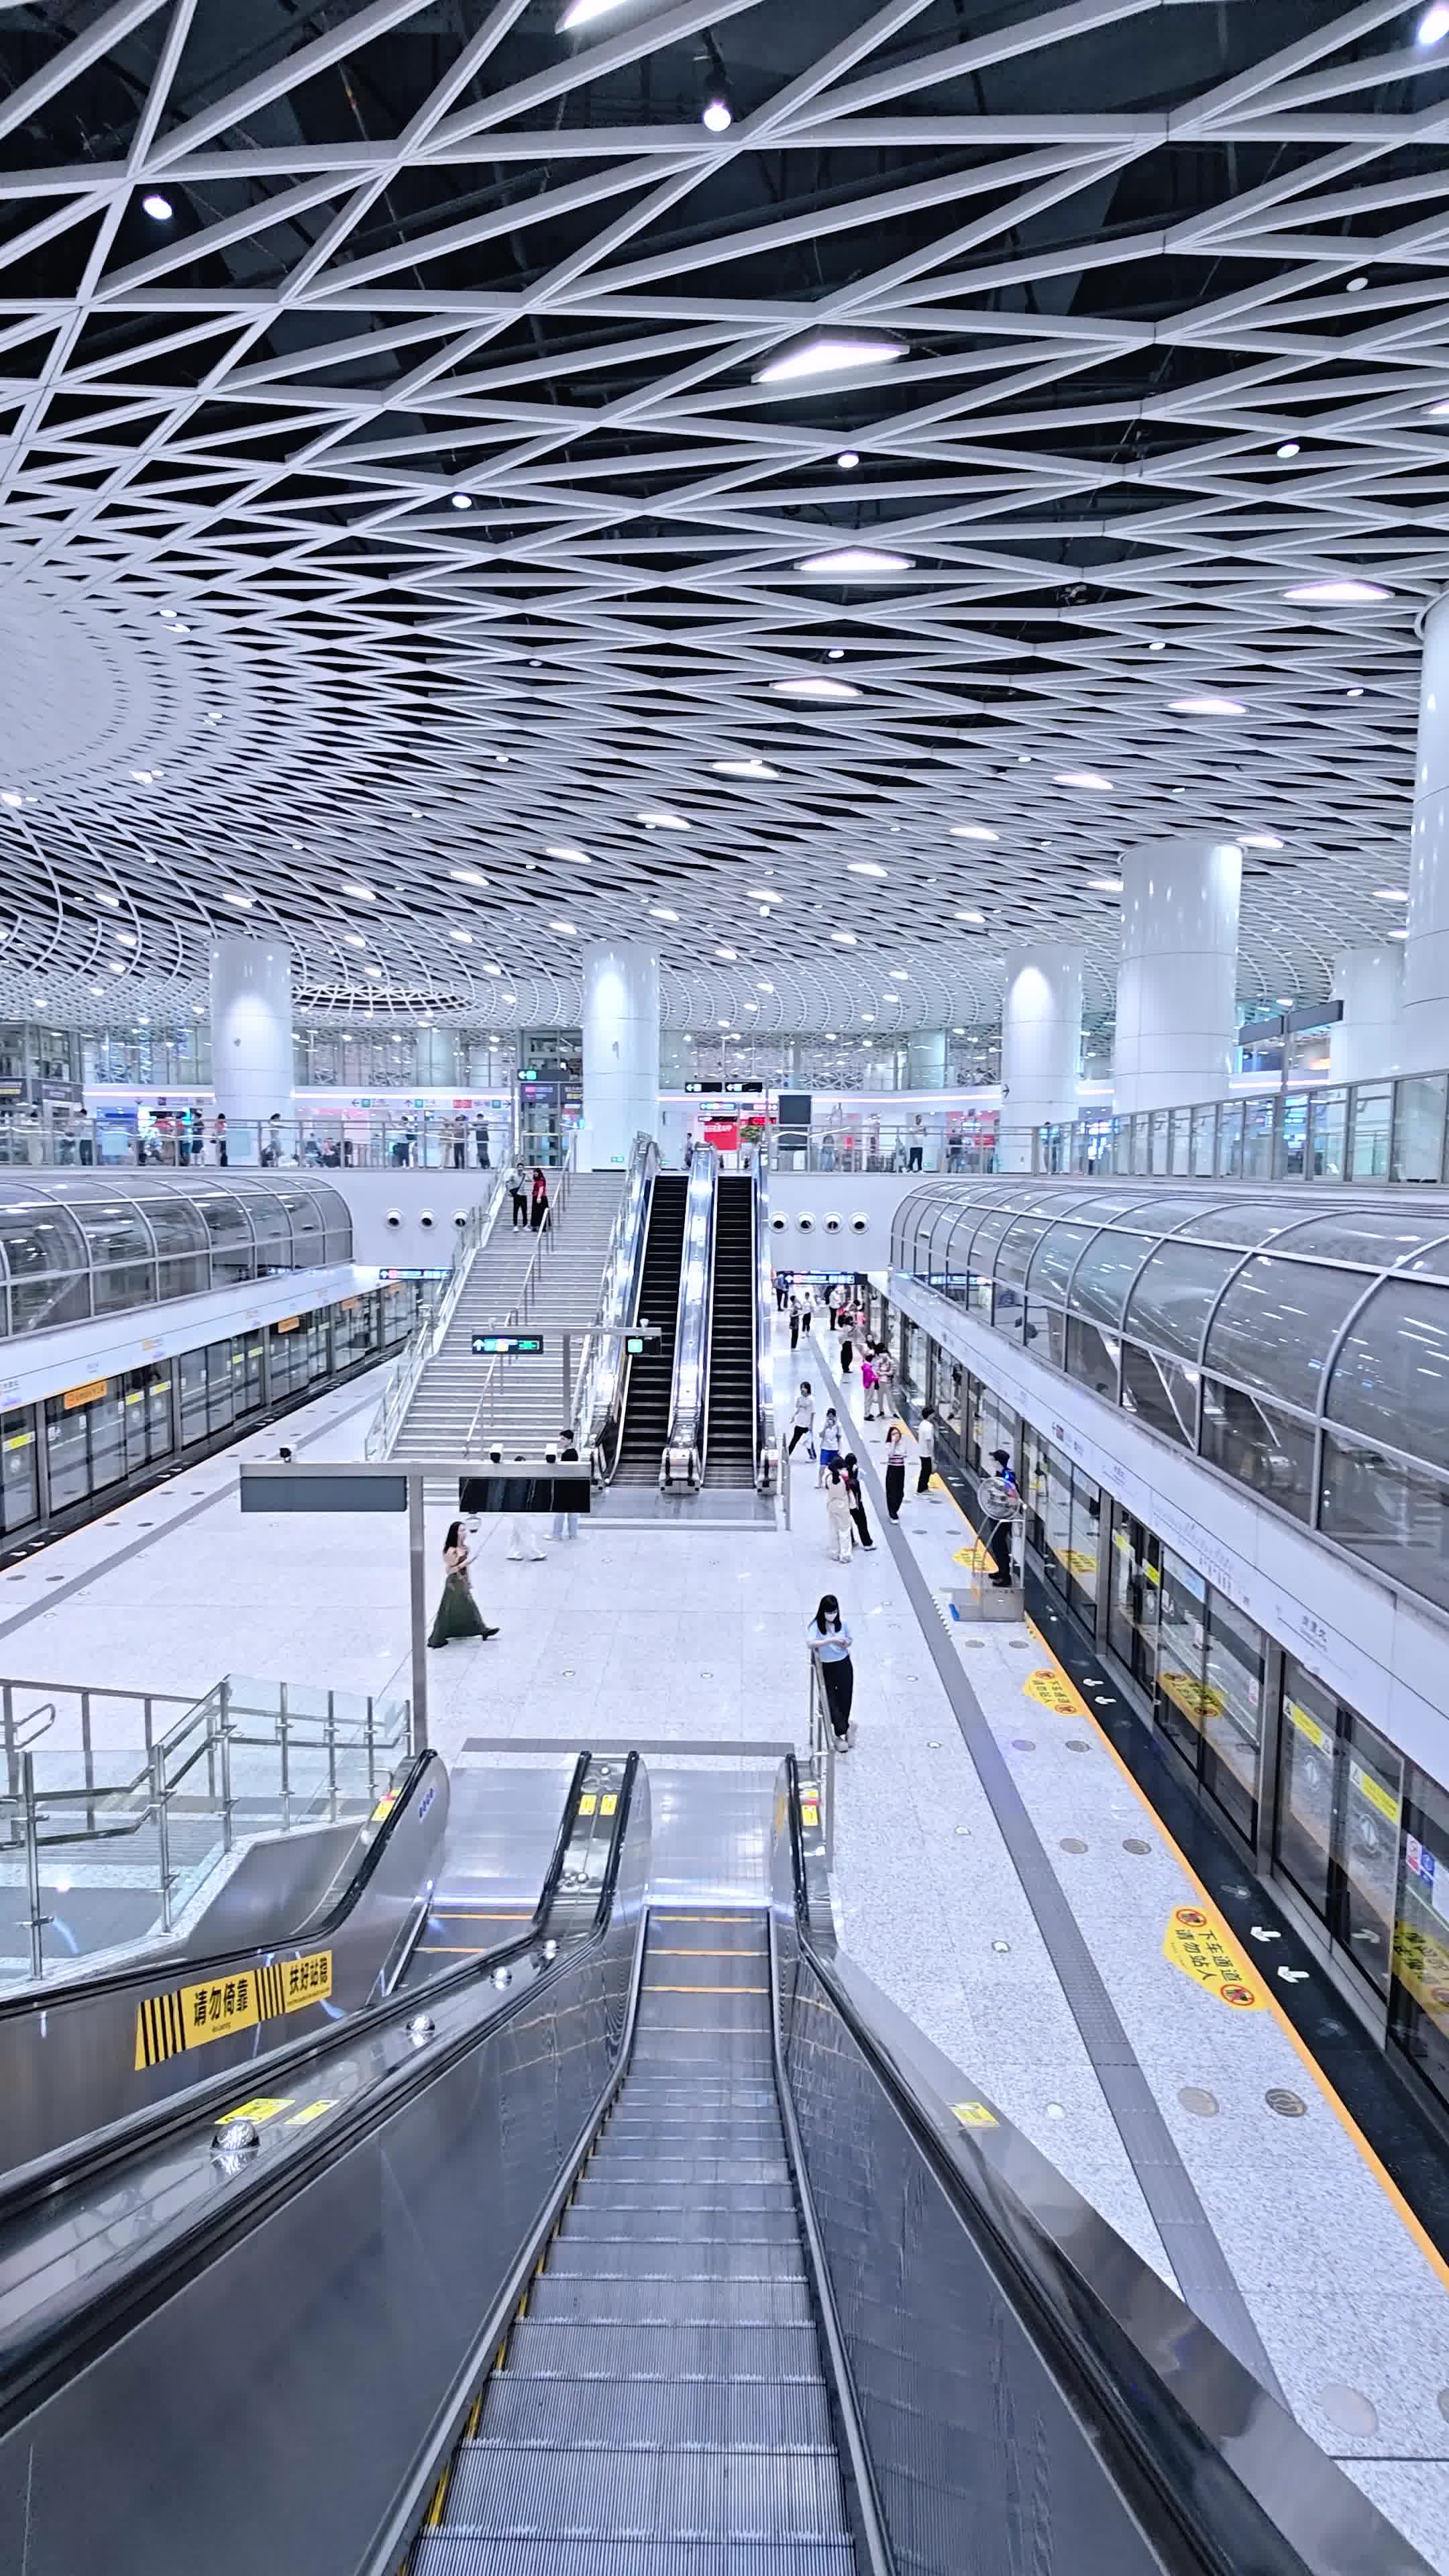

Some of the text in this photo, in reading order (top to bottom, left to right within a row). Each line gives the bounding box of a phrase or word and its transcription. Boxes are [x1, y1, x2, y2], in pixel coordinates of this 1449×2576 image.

[290, 1957, 327, 1995] 扶好站稳
[1175, 1929, 1219, 1981] 请勿站人
[1197, 1929, 1242, 1981] 下车通道
[194, 1978, 248, 2026] 请勿倚靠
